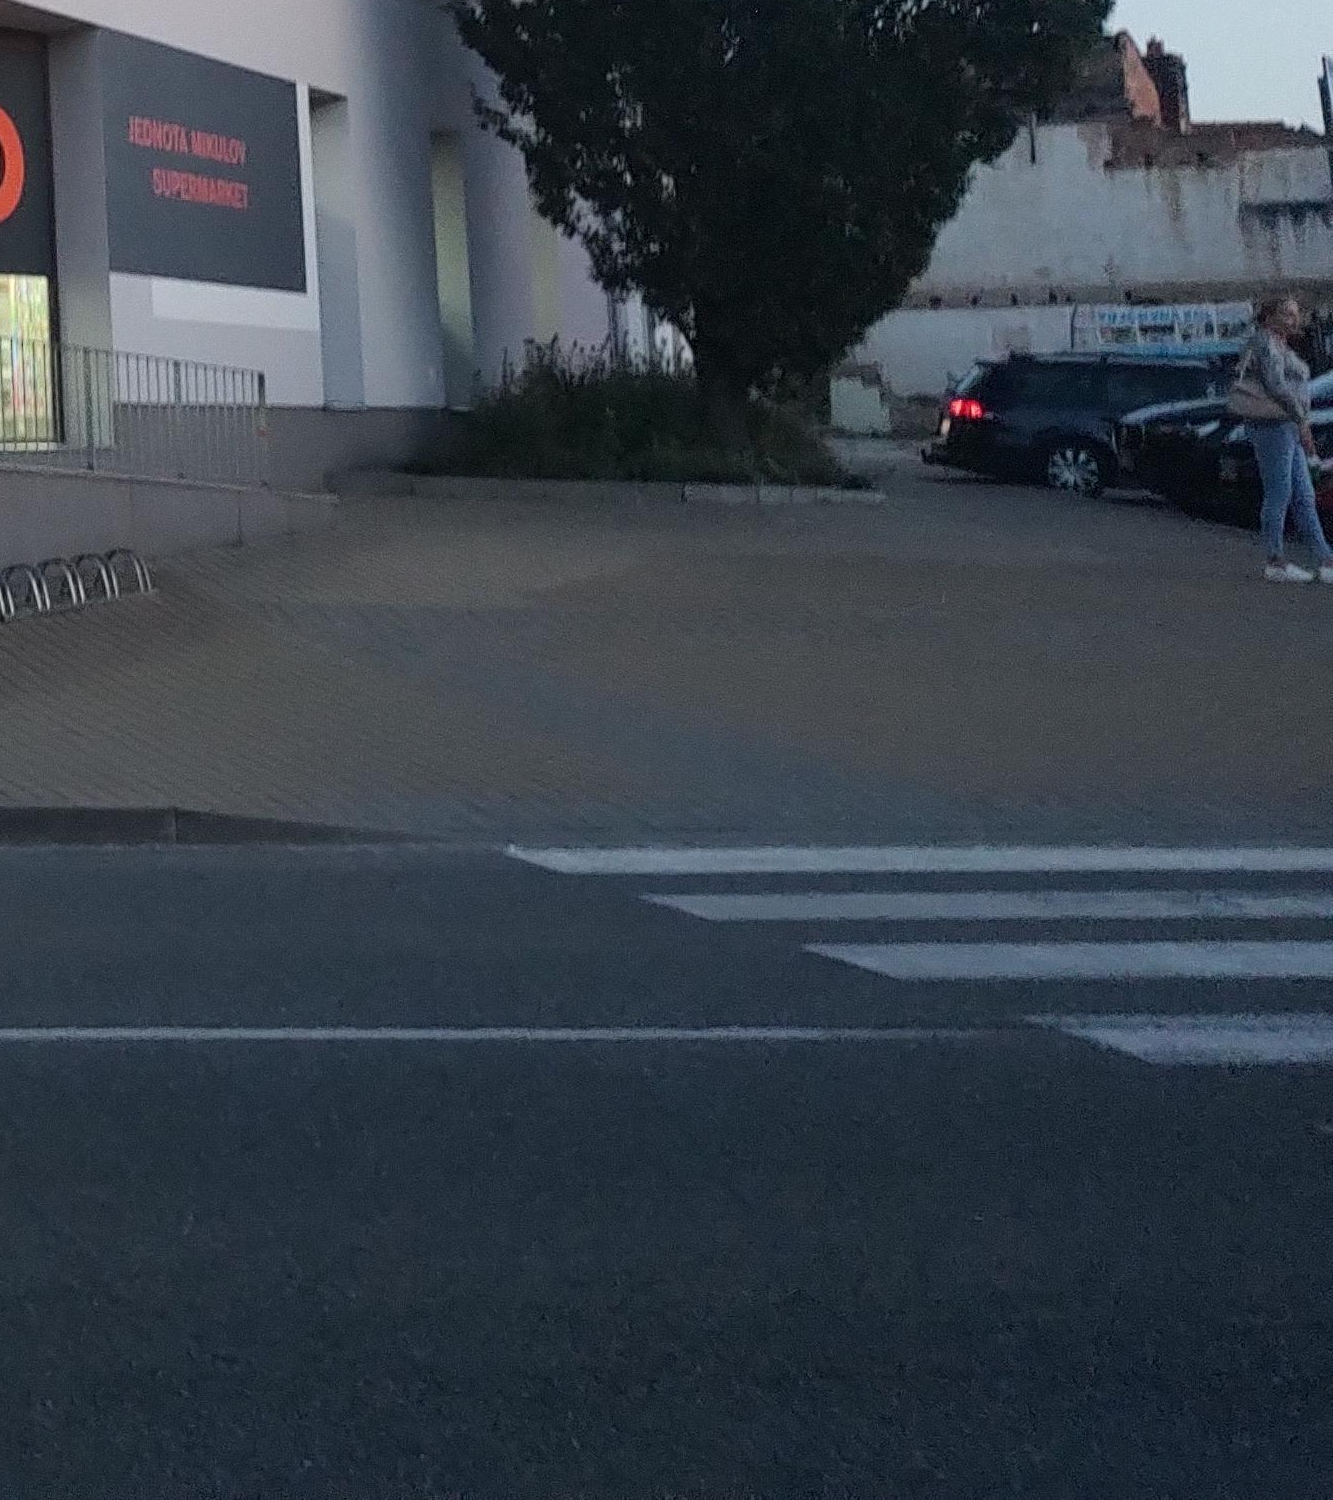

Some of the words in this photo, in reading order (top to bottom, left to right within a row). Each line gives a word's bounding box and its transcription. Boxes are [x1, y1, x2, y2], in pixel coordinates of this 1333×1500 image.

[128, 115, 188, 154] JEDNOTA
[191, 129, 246, 166] MIKULOV
[151, 168, 249, 211] SUPERMARKET
